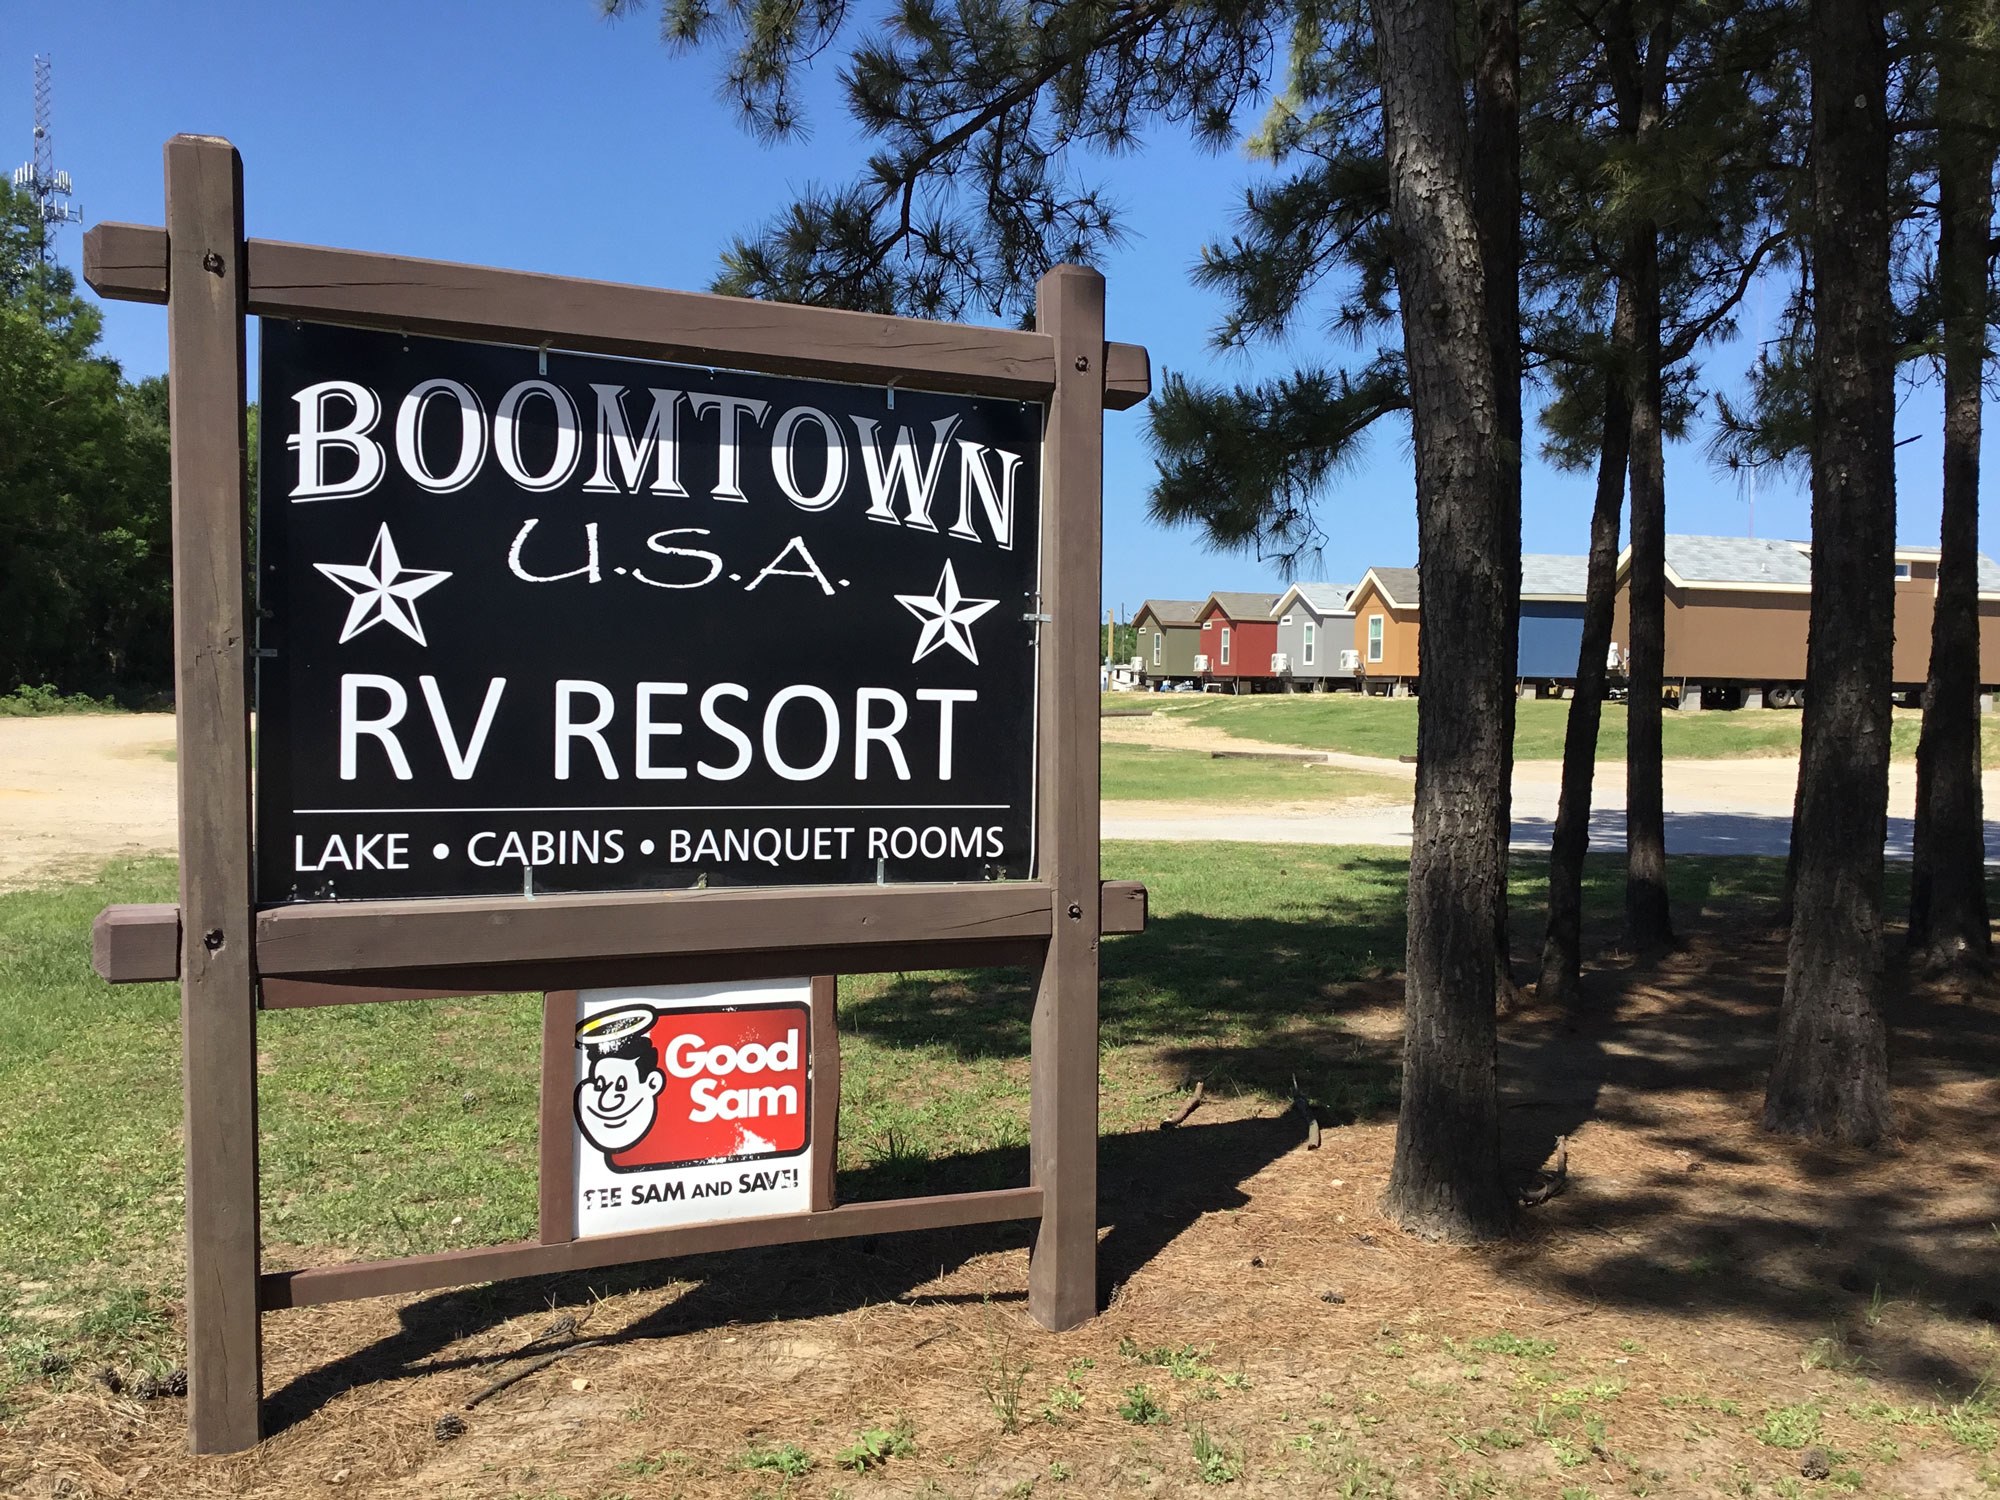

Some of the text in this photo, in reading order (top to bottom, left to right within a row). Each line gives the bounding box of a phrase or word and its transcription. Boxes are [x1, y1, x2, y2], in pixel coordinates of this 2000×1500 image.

[286, 379, 1024, 551] BOOMTOWN
[508, 517, 851, 596] U.S.A.
[339, 673, 978, 781] RV RESORT
[294, 825, 1005, 872] LAKE CABINS BANQUET ROOMS
[665, 1029, 799, 1079] Good
[688, 1078, 798, 1123] Sam
[631, 1181, 686, 1205] SAM
[691, 1180, 733, 1199] AND
